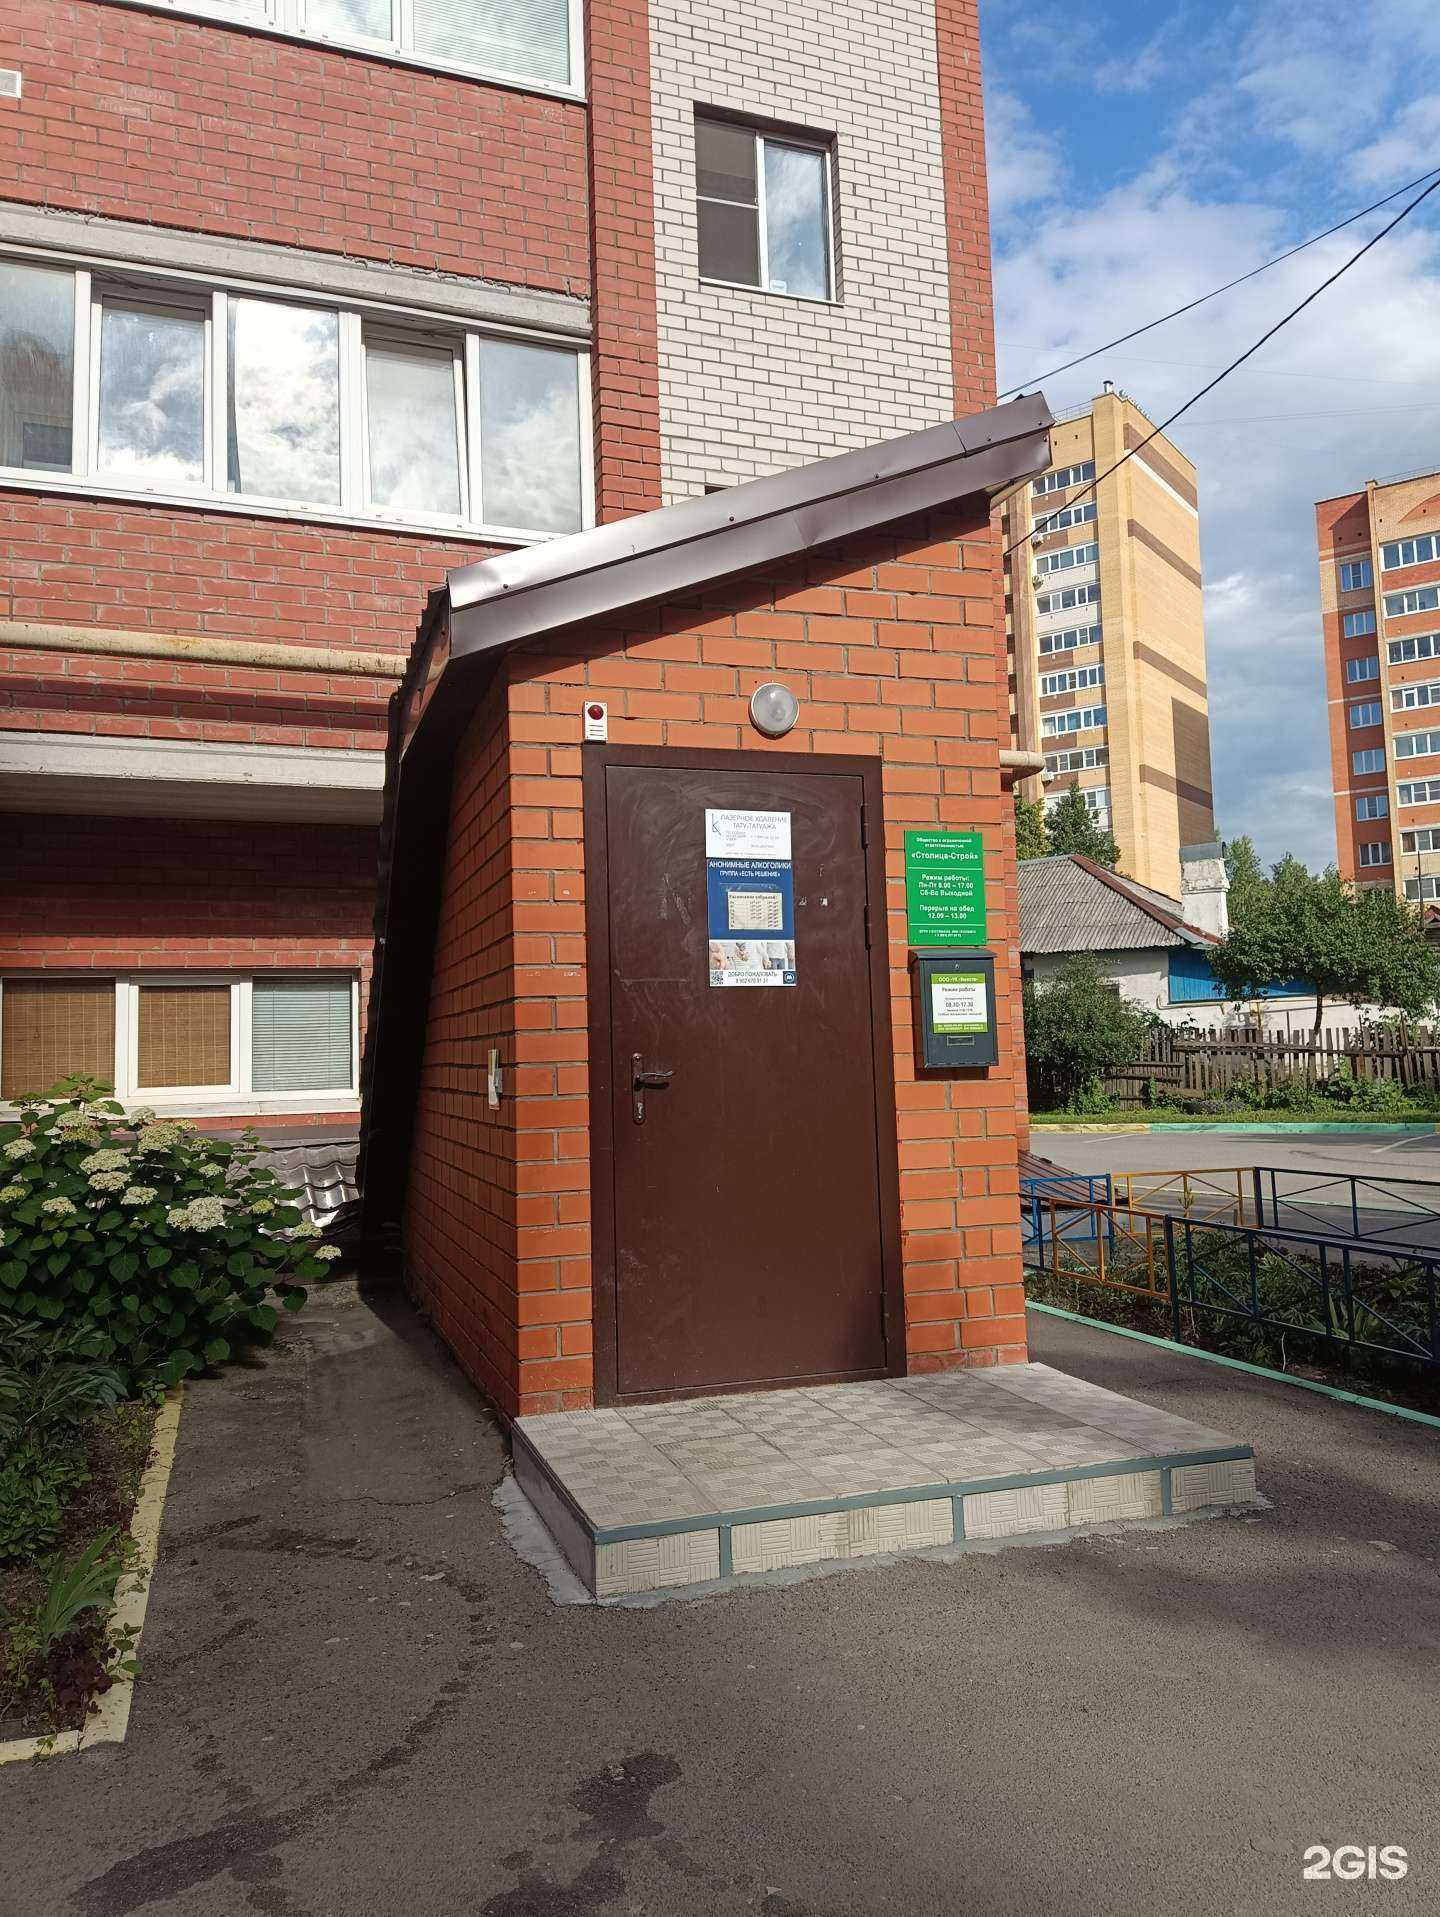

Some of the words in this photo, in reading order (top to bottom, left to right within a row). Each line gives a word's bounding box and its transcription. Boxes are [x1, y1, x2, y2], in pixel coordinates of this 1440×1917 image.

[720, 814, 753, 822] ЛАЗЕРНОЕ
[911, 851, 978, 861] «Столица-Строй»
[709, 861, 750, 869] АНОНИМНЫЕ
[751, 861, 792, 869] АЛКОГОЛИКИ
[944, 874, 970, 882] работы:
[940, 889, 973, 897] Выходной
[919, 904, 949, 912] Перерыв
